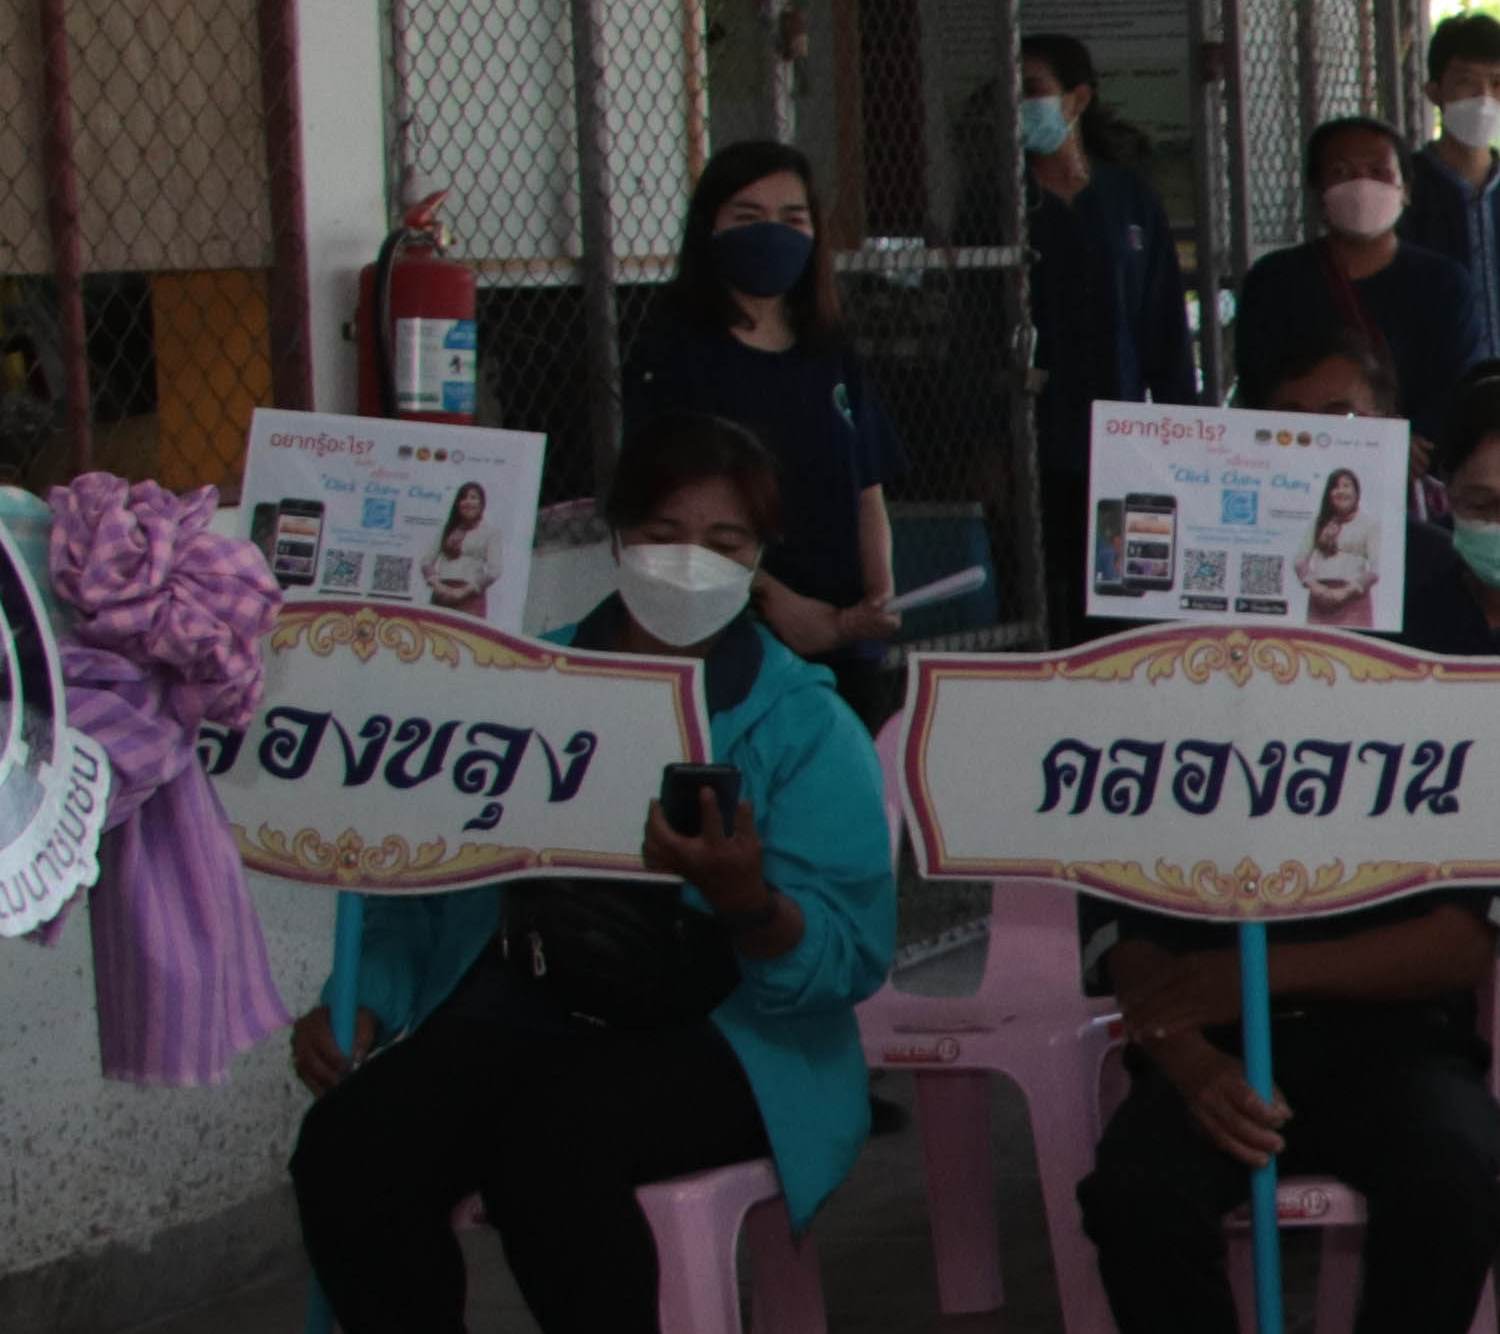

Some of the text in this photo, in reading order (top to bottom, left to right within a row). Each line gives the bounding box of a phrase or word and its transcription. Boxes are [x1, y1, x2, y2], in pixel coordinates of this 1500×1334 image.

[270, 432, 375, 457] อยากรู้อะไร?
[1106, 417, 1227, 446] อยากรู้อะไร?
[1035, 736, 1475, 818] คลองลาน
